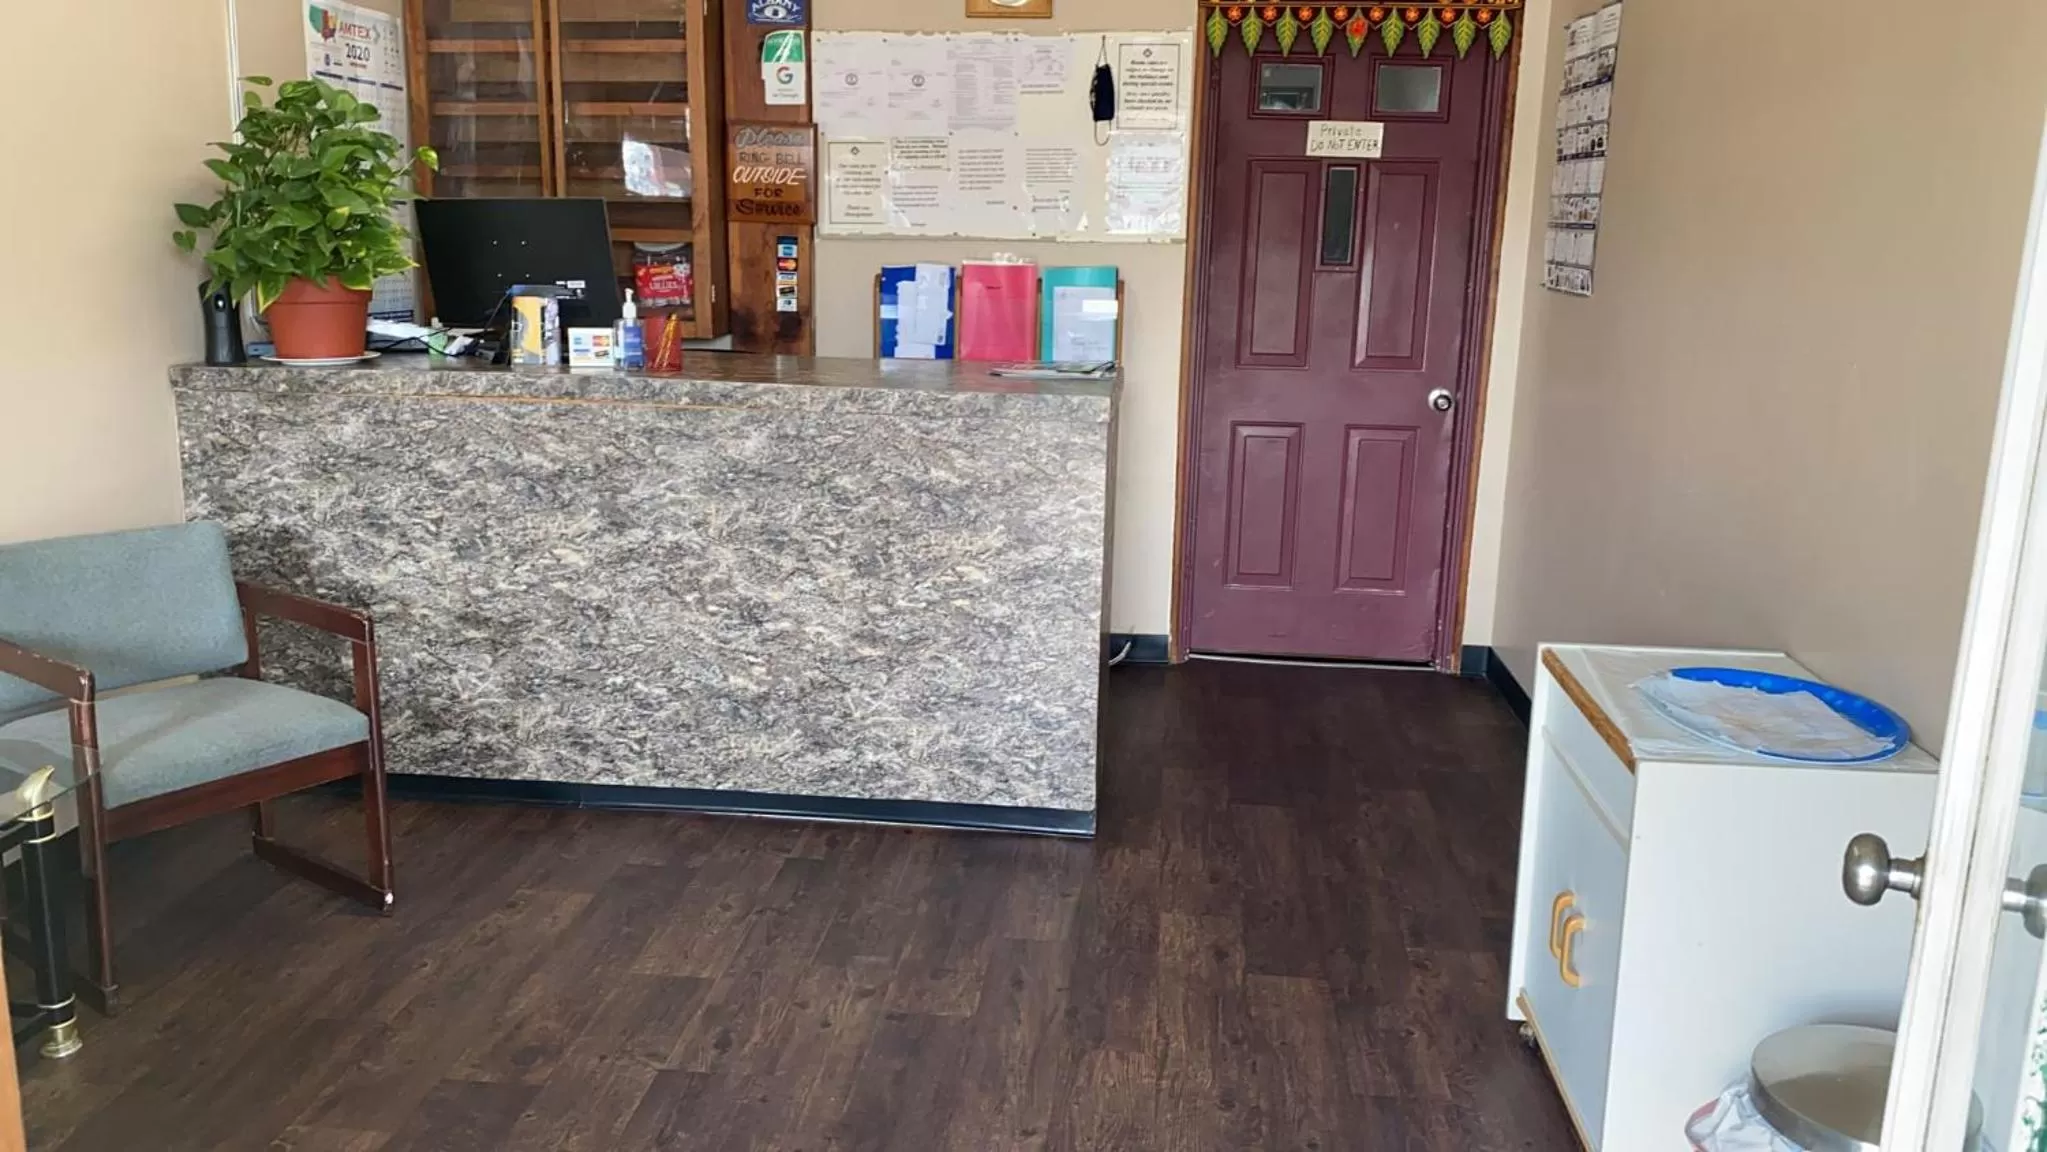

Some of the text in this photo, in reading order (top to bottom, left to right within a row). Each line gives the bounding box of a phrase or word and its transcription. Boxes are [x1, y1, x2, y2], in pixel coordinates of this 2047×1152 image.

[345, 42, 371, 61] 2020
[776, 66, 794, 85] G
[735, 127, 805, 148] Please
[1320, 123, 1363, 137] Private
[1347, 138, 1378, 152] ENTER
[775, 153, 806, 165] BELL
[732, 165, 809, 186] OUTSIDE
[754, 187, 785, 198] FOR
[735, 198, 804, 216] Service
